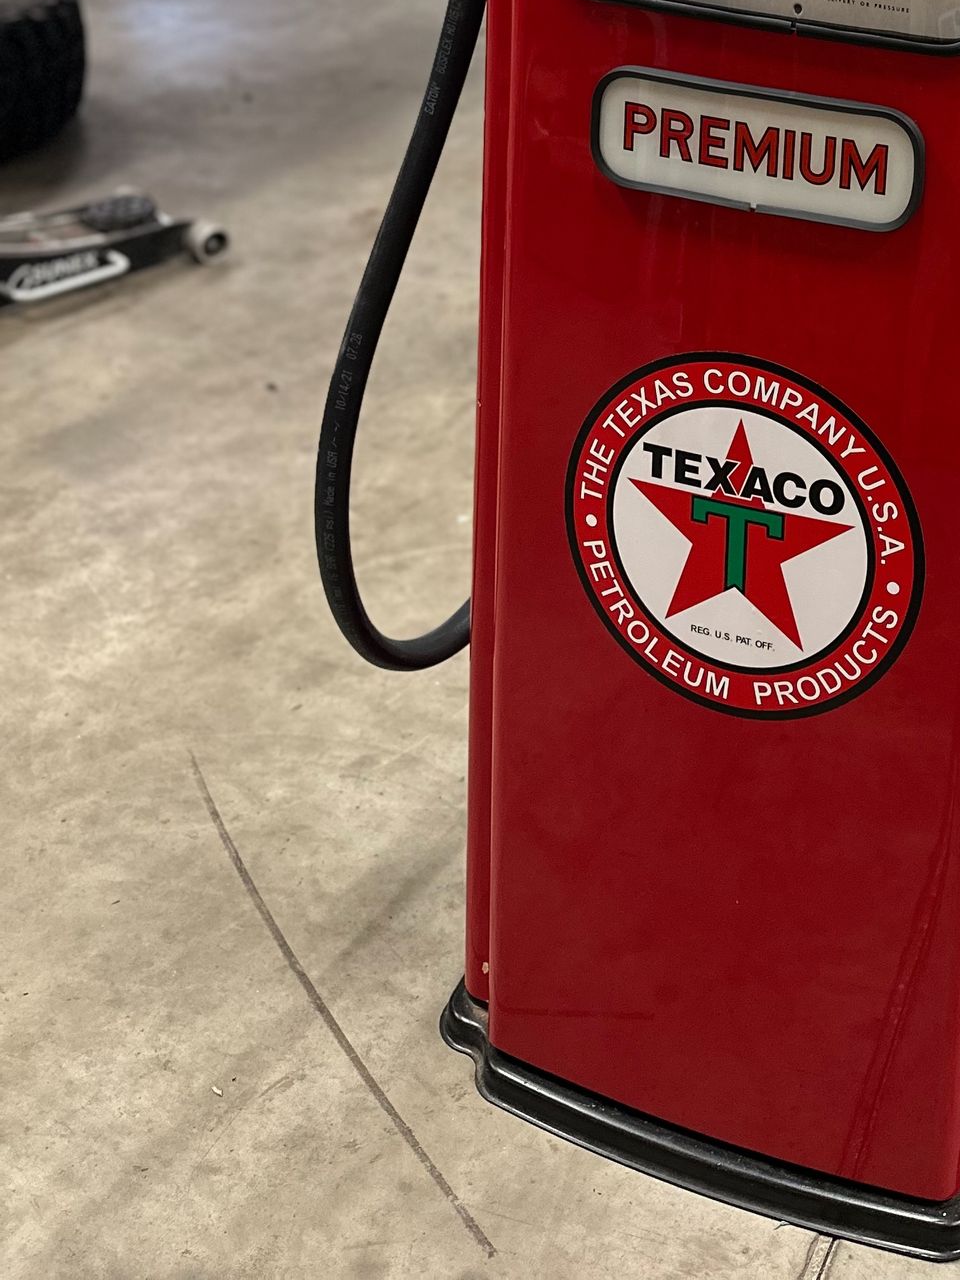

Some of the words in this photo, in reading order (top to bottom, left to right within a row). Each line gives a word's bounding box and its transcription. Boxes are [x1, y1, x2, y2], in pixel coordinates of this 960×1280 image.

[860, 0, 870, 8] OR
[874, 3, 911, 14] PRESSURE
[622, 100, 890, 197] PREMIUM
[335, 369, 353, 411] 10/14/21
[325, 450, 339, 469] USA
[580, 438, 616, 501] THE
[602, 371, 694, 440] TEXAS
[702, 368, 866, 461] COMPANY
[856, 464, 906, 566] U.S.A.
[642, 441, 846, 517] TEXACO
[582, 538, 731, 700] PETROLEUM
[752, 604, 900, 706] PRODUCTS
